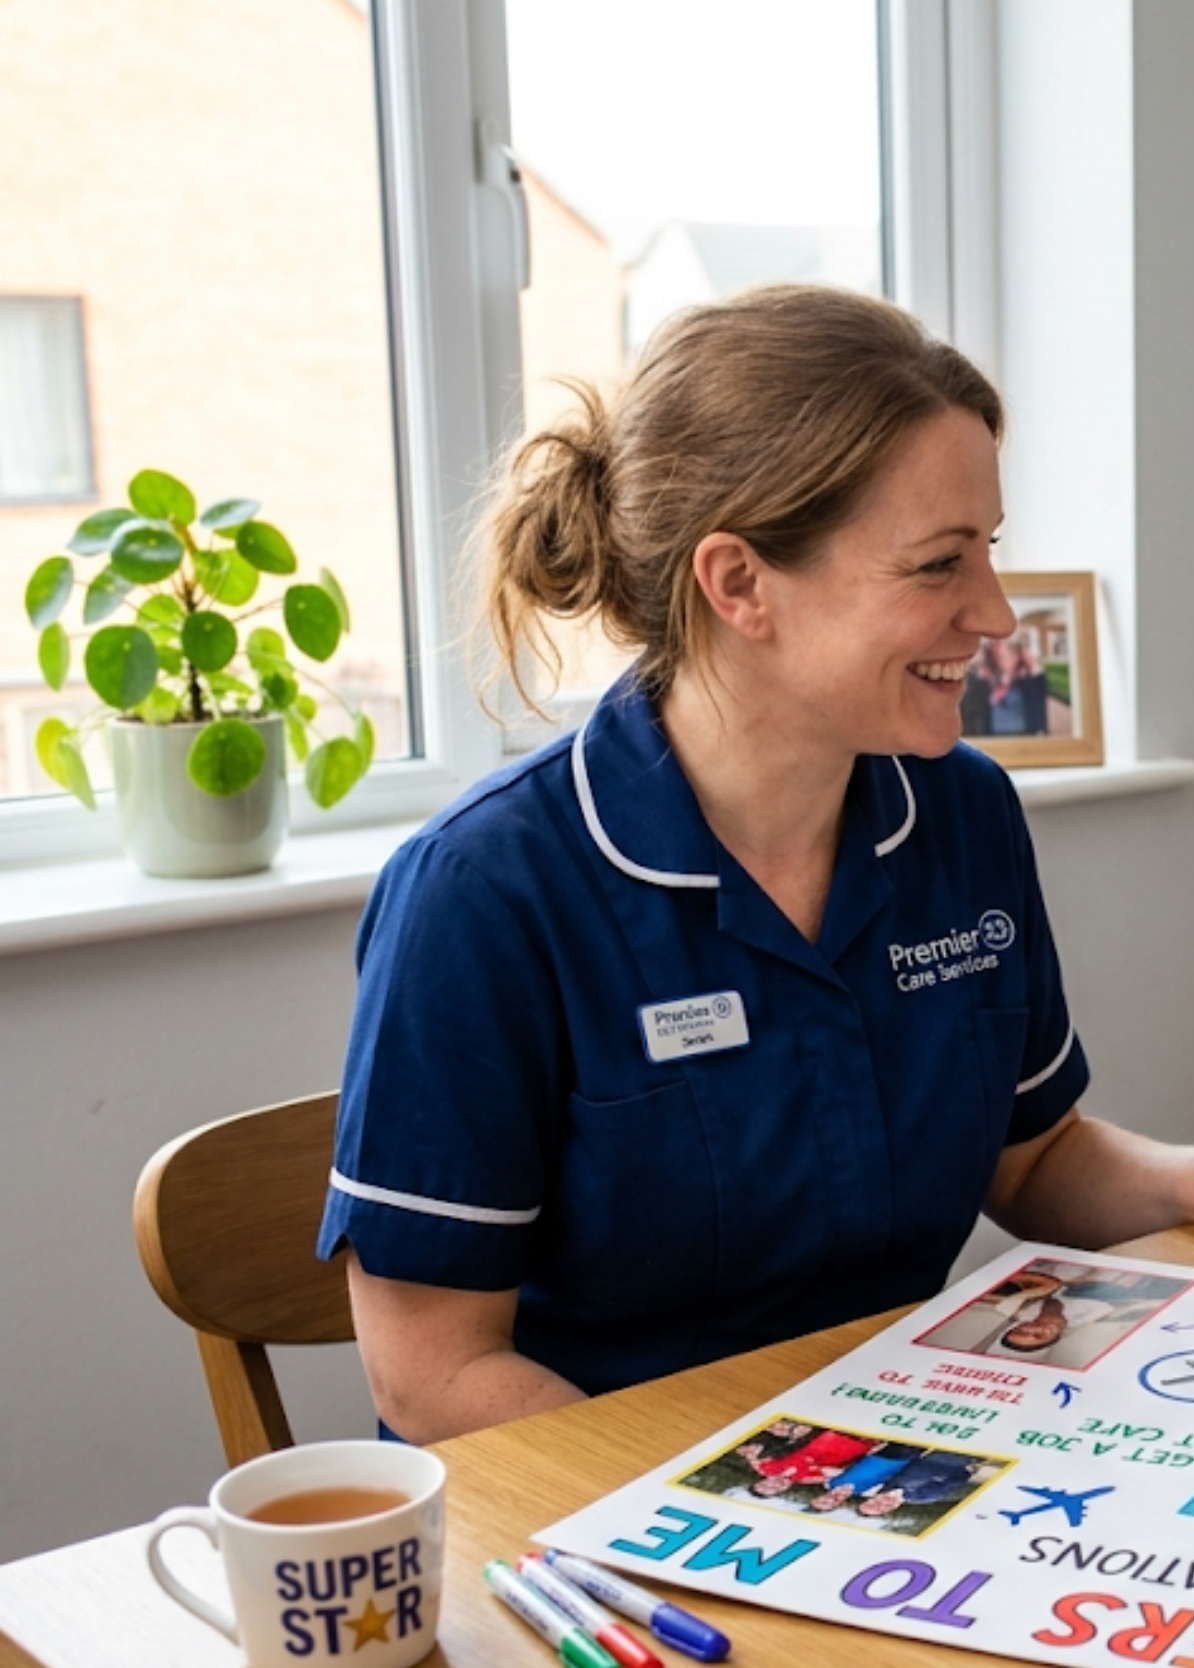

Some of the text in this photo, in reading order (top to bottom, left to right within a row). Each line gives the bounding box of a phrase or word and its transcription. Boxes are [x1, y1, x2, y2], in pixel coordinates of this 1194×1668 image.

[887, 928, 979, 971] Premier
[1015, 1430, 1194, 1468] GET A JOB
[275, 1537, 421, 1602] SUPER
[608, 1506, 820, 1586] ME
[281, 1585, 422, 1658] STR
[840, 1559, 993, 1629] TO
